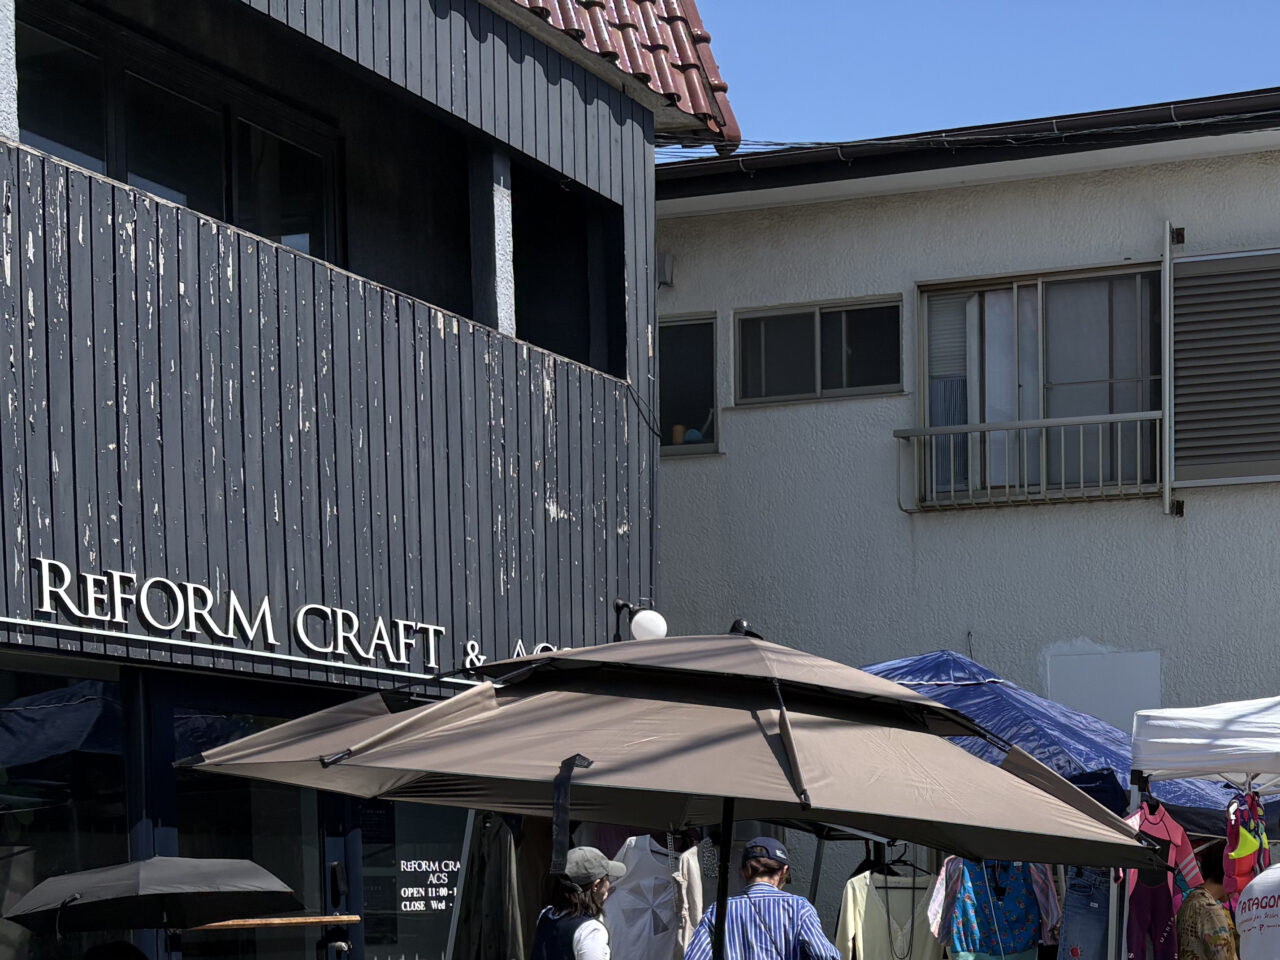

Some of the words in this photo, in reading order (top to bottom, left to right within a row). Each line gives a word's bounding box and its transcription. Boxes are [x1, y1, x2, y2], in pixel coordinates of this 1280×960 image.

[34, 556, 281, 646] REFORM
[295, 603, 446, 669] CRAFT
[464, 640, 487, 674] &
[400, 860, 440, 872] REFORM
[427, 872, 449, 885] ACS
[401, 887, 426, 898] OPEN
[401, 901, 426, 911] CLOSE
[430, 900, 446, 910] Wed
